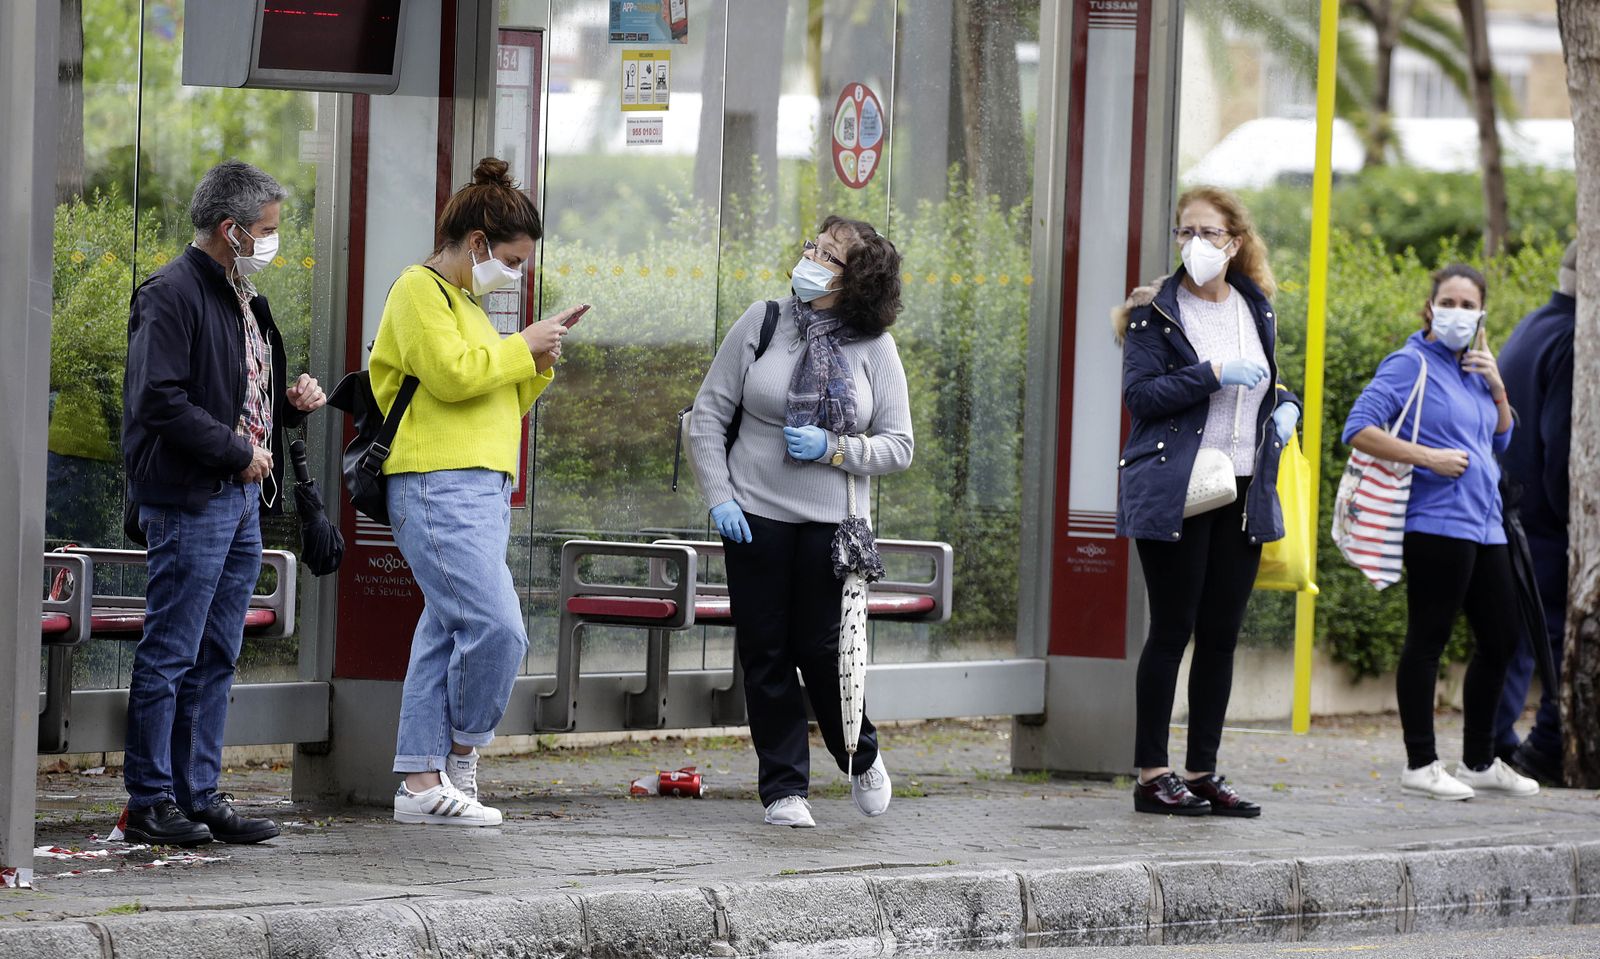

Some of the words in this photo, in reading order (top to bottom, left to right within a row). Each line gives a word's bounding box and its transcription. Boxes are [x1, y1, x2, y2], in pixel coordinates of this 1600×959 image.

[1090, 1, 1138, 10] TUSSAM
[354, 573, 416, 585] AYUNTAMIENT
[378, 585, 412, 597] SEVILLA
